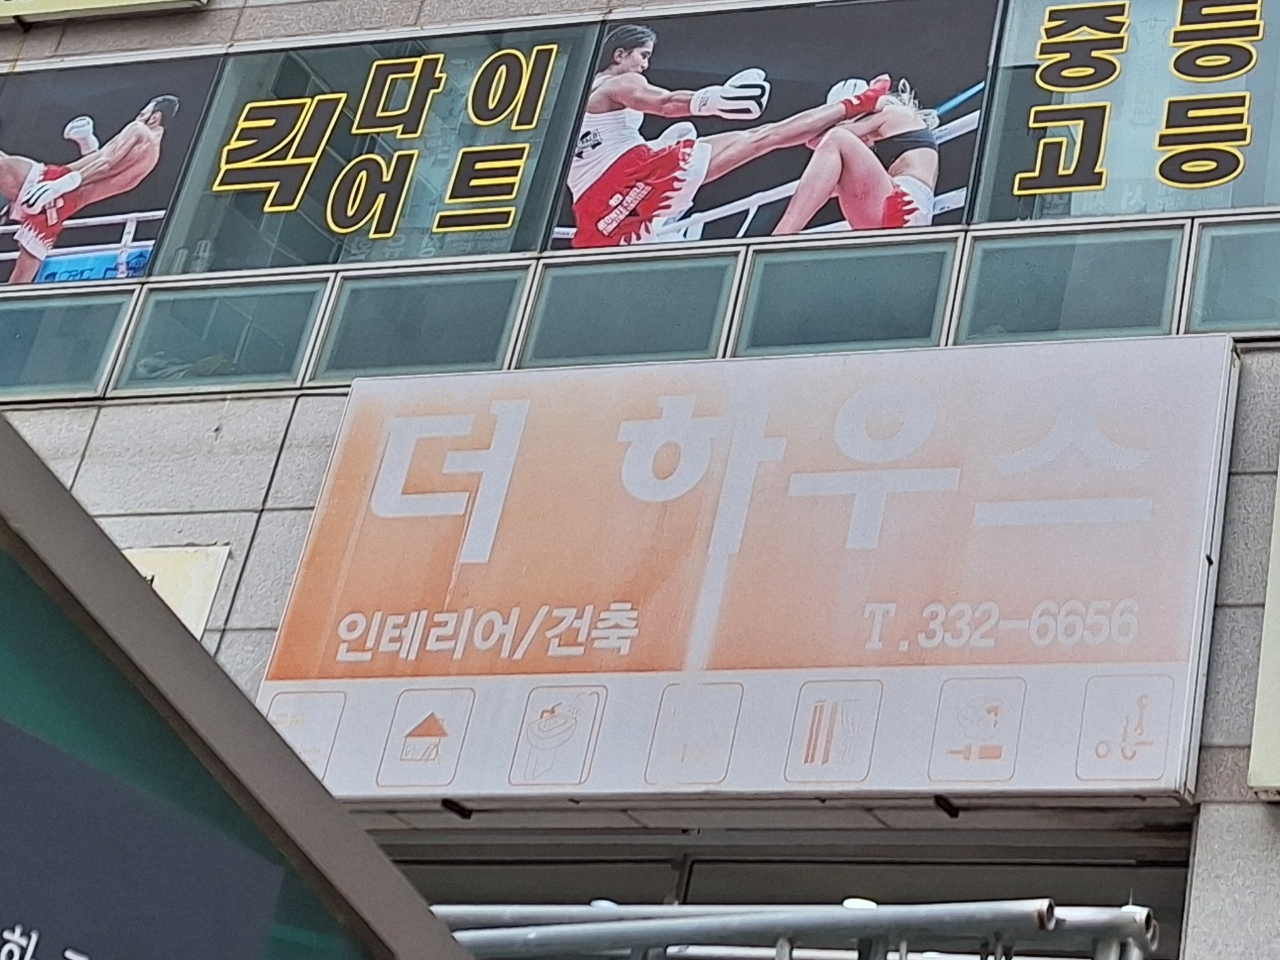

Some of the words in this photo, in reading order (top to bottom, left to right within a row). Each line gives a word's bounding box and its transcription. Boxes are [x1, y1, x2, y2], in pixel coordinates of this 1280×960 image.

[371, 397, 531, 565] 더
[334, 601, 641, 663] 인테리어/건축
[862, 597, 1140, 654] T.332-6656
